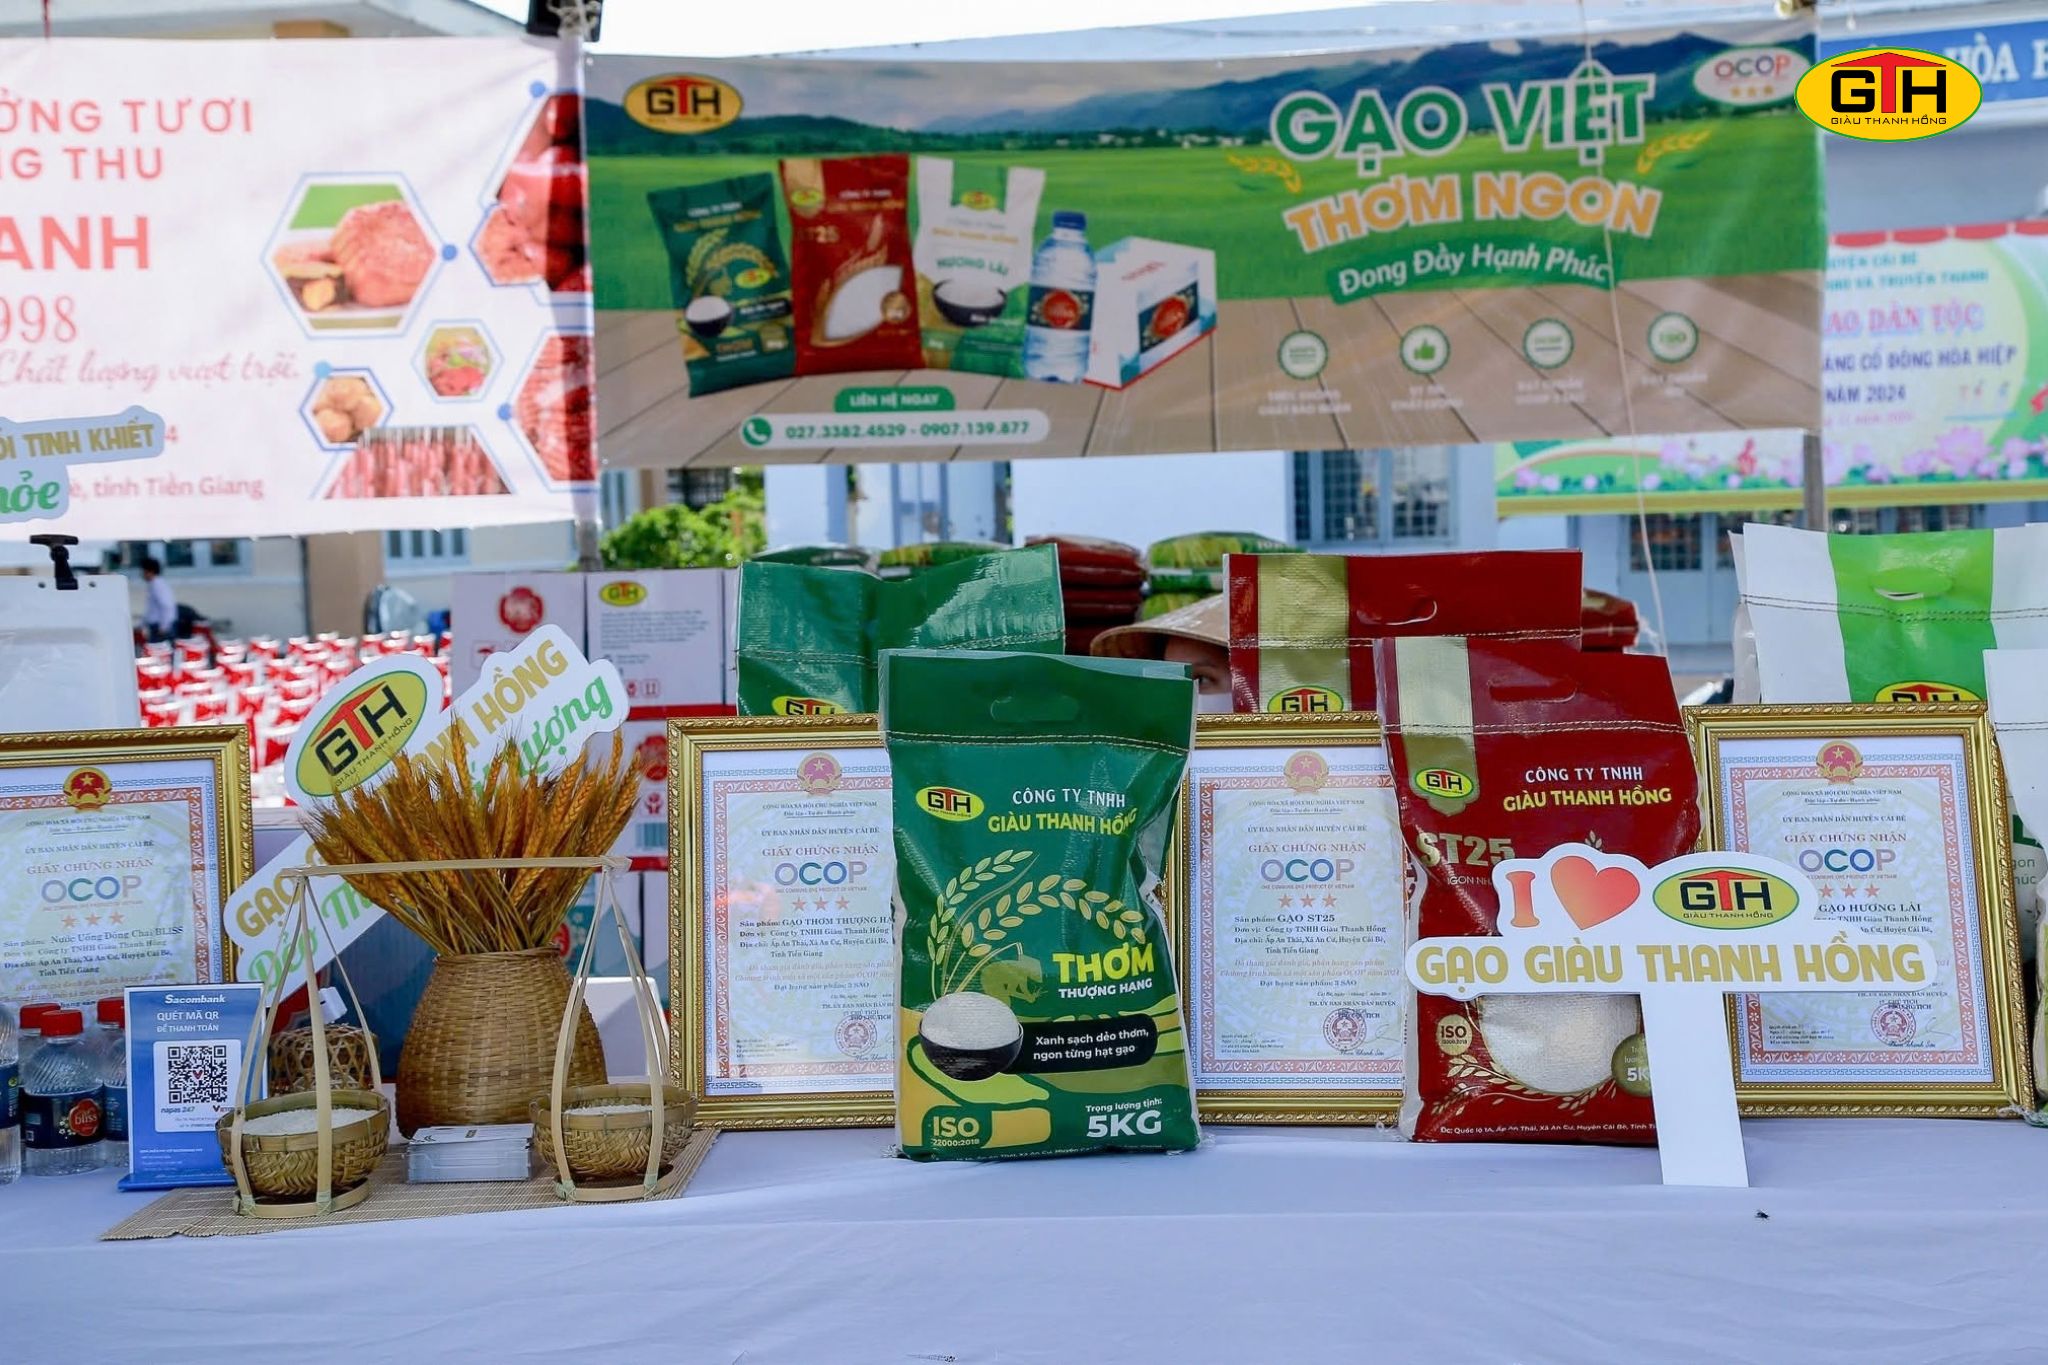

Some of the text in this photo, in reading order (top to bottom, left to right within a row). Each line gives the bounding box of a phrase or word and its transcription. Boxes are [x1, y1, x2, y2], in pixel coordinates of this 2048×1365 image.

[1715, 55, 1791, 78] OCOP
[646, 75, 720, 115] GTH
[122, 98, 254, 133] TƯƠI
[1272, 63, 1653, 174] GẠO VIỆT
[63, 147, 164, 180] THU
[1286, 174, 1660, 250] THƠM NGON
[1339, 243, 1610, 296] Đong Đầy Hạnh Phúc
[881, 392, 896, 409] HỆ
[901, 394, 939, 406] NGAY
[88, 416, 154, 451] KHIẾT
[199, 477, 264, 500] Giang
[472, 639, 569, 735] HỒNG
[1280, 688, 1329, 712] GTH
[311, 681, 407, 776] GTH
[389, 717, 413, 739] HỒNG
[519, 675, 613, 778] ượng
[1426, 769, 1462, 792] GTH
[1525, 766, 1643, 784] CÔNG TY TNHH
[927, 787, 971, 813] GTH
[1012, 787, 1125, 807] CÔNG TY TNHH
[1503, 784, 1672, 812] GIÀU THANH HỒNG
[988, 808, 1138, 835] GIÀU THANH HỒNG
[2012, 814, 2044, 849] L
[1249, 841, 1367, 854] GIẤY CHỨNG NHẬN
[1784, 831, 1907, 843] GIẤY CHỨNG NHẬN
[762, 843, 879, 856] GIẤY CHỨNG NHẬN
[1417, 832, 1516, 867] ST25
[1799, 849, 1896, 872] OCOP
[27, 861, 60, 875] GIẤY
[775, 861, 867, 886] OCOP
[1261, 859, 1355, 882] OCOP
[41, 874, 142, 903] OCOP
[1505, 871, 1539, 928] I
[1679, 870, 1772, 911] GTH
[1277, 914, 1335, 924] GẠO ST25
[1818, 903, 1896, 914] GẠO HƯƠNG
[836, 917, 878, 925] THƯỢNG
[1052, 943, 1155, 984] THƠM
[1416, 931, 1925, 994] GẠO GIÀU THANH HỒNG
[165, 994, 226, 1003] Sacombank
[1058, 978, 1153, 999] THƯỢNG HẠNG
[157, 1010, 219, 1021] QUÉT MÃ QR
[157, 1024, 167, 1032] ĐỂ
[197, 1023, 218, 1031] TOÁN
[1036, 1029, 1149, 1046] Xanh sạch dẻo thơm,
[1440, 1025, 1466, 1038] ISO
[1033, 1045, 1135, 1061] ngon từng hạt gạo
[1086, 1097, 1163, 1114] Trọng lượng tịnh:
[933, 1116, 980, 1139] ISO
[1086, 1110, 1162, 1139] 5KG
[1454, 1126, 1474, 1134] Quốc
[932, 1138, 980, 1148] 22000:2018
